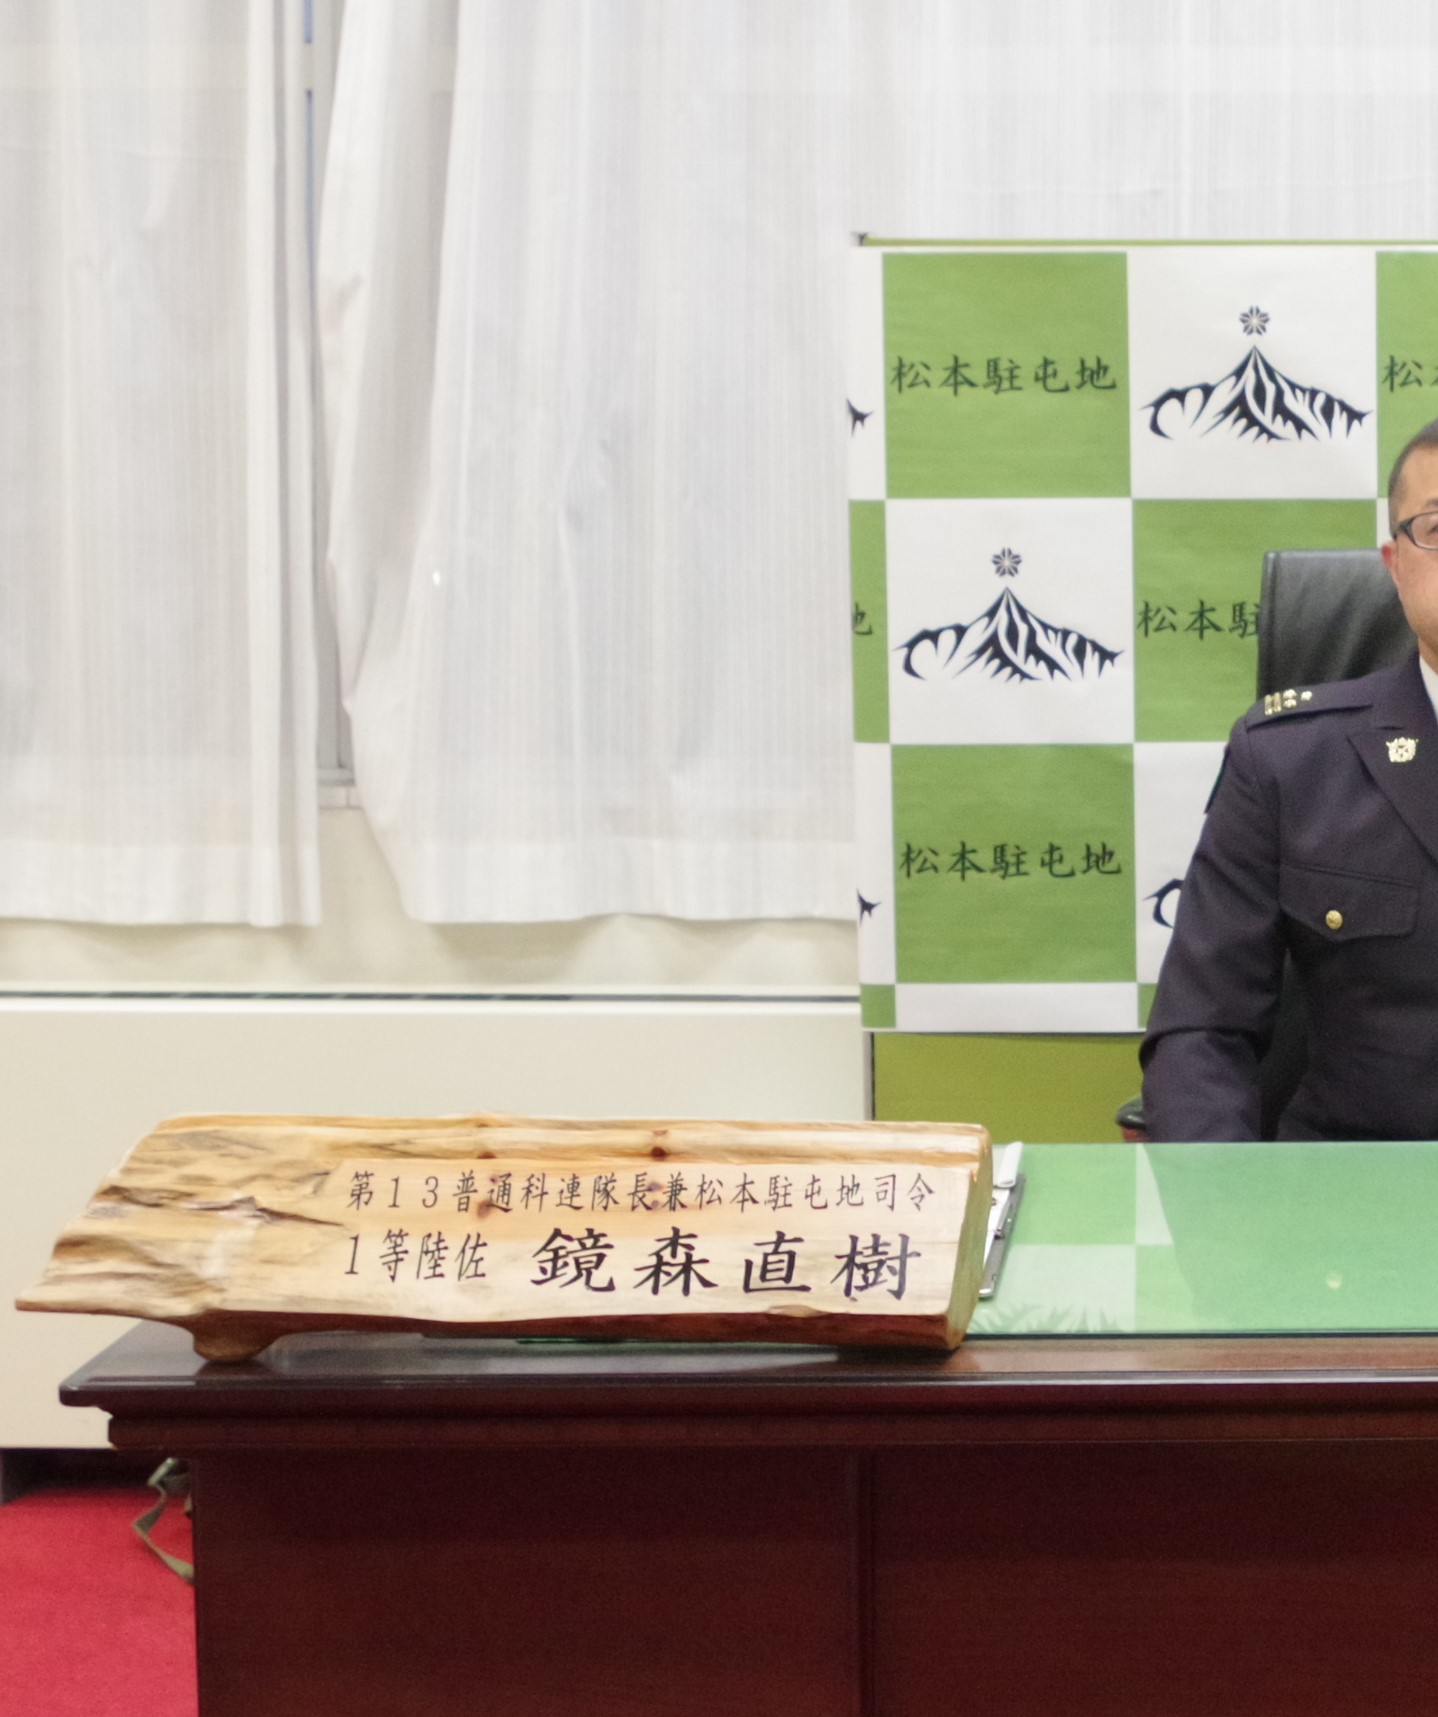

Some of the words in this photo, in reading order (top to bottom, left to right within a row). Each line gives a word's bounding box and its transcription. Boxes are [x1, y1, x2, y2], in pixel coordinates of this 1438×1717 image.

[890, 355, 1116, 396] 松本駐屯地
[899, 842, 1121, 881] 松本駐屯地
[345, 1229, 487, 1282] 1等陸佐
[531, 1226, 921, 1301] 鏡森直樹
